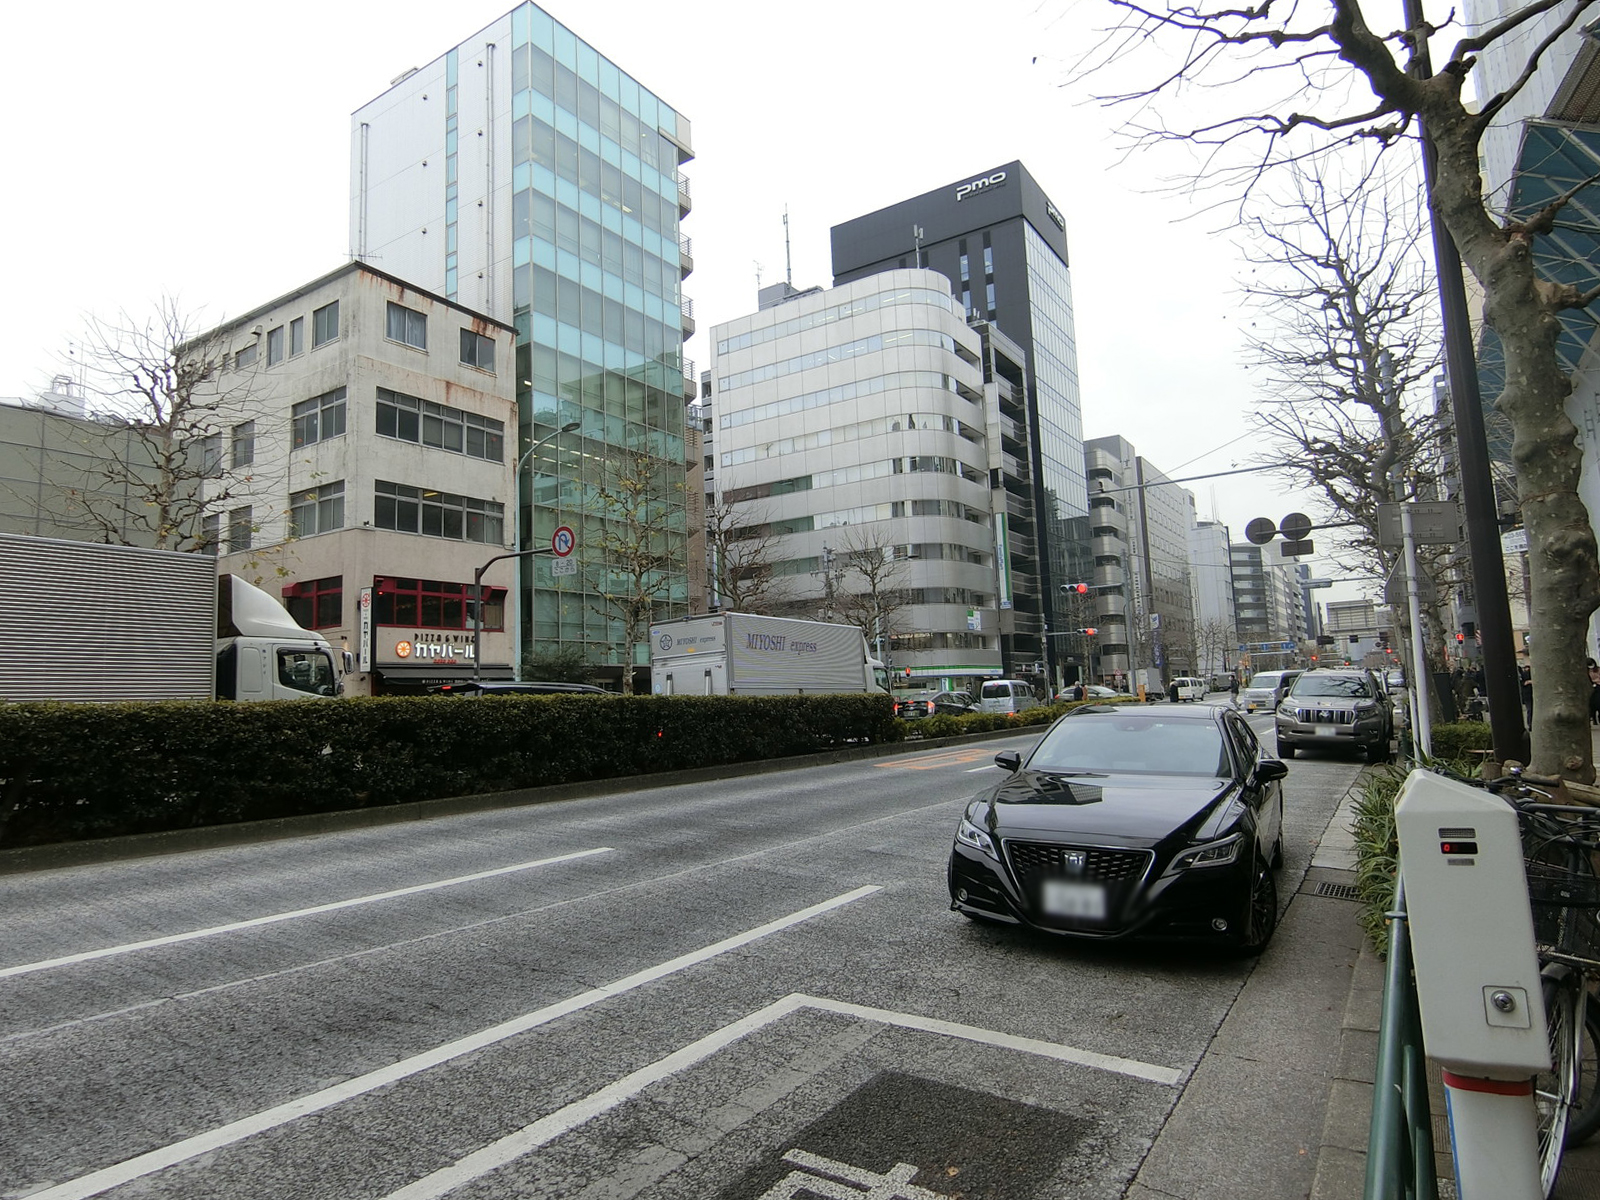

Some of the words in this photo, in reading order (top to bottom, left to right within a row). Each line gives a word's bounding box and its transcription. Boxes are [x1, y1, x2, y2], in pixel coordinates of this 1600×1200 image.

[414, 633, 441, 642] PIZZA
[746, 633, 786, 651] MIYOSHI
[790, 641, 817, 655] express
[415, 642, 475, 658] カヤバール
